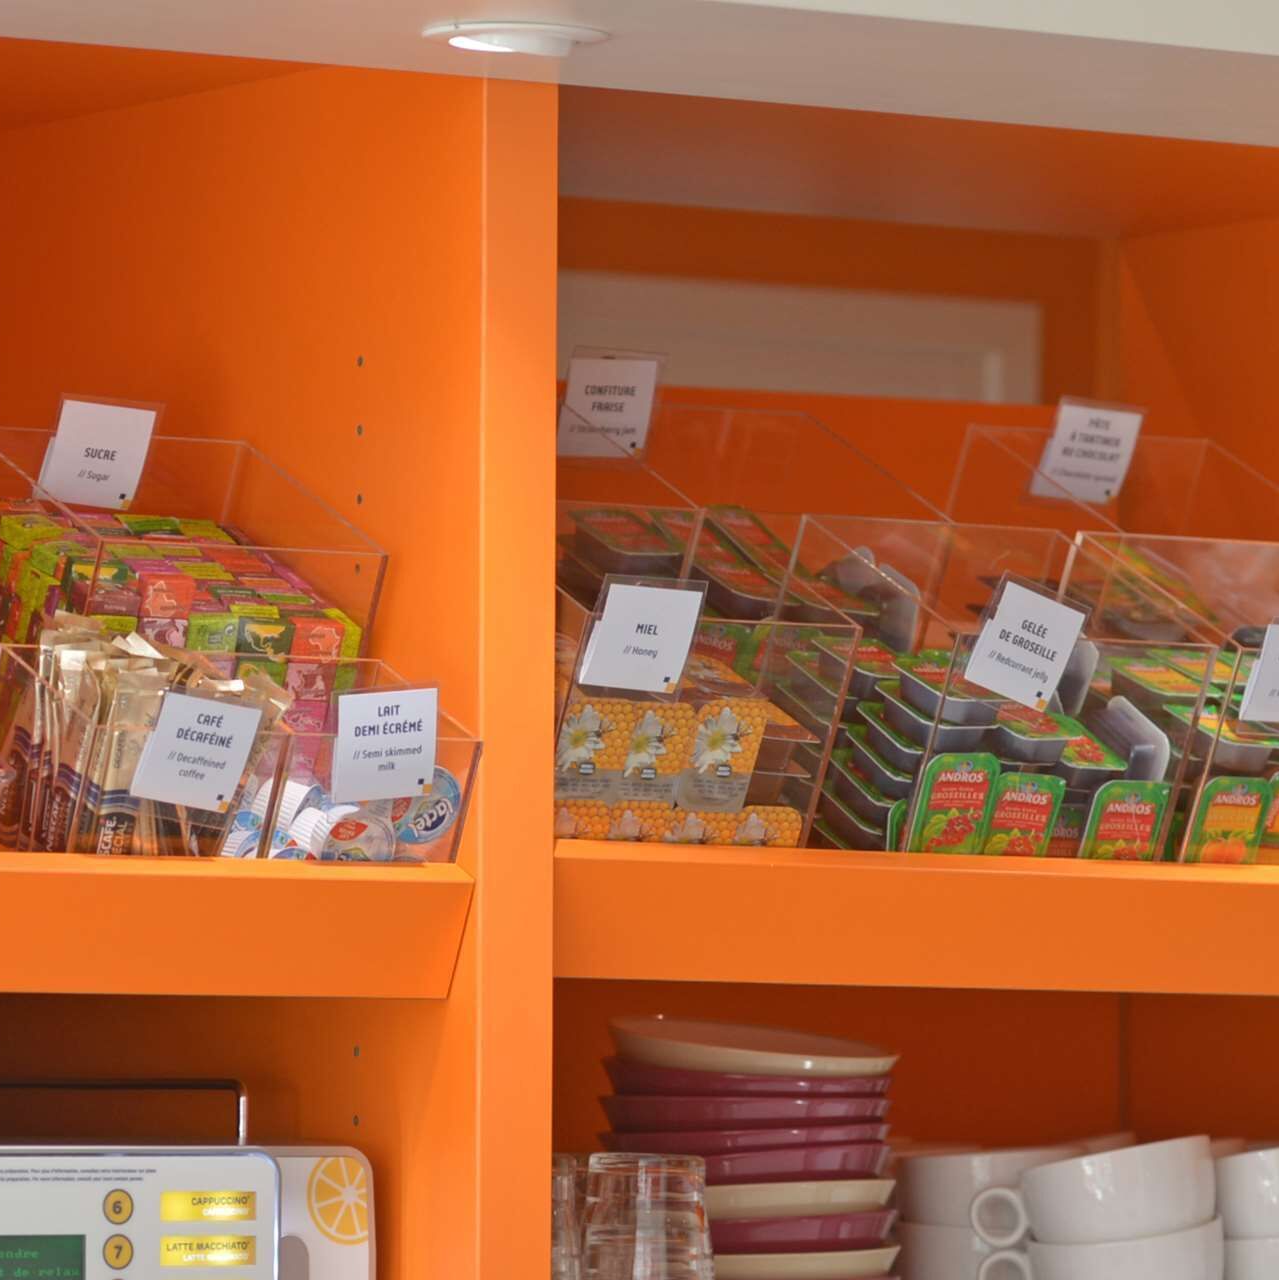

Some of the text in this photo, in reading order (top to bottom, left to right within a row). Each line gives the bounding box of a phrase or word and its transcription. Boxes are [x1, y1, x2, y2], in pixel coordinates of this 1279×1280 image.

[84, 447, 118, 461] SUCRE
[87, 470, 110, 482] Sugar
[635, 623, 658, 636] MIEL
[1021, 619, 1048, 639] GELÉE
[999, 629, 1057, 662] DE GROSEILLE
[632, 646, 658, 659] Honey
[378, 704, 400, 717] LAIT
[196, 713, 224, 728] CAFÉ
[354, 718, 423, 737] DEMI ÉCRÉMÉ
[176, 727, 233, 748] DÉCAFÉINÉ
[362, 745, 422, 759] Semi skimmed
[176, 752, 226, 770] Decaffeined
[378, 761, 395, 771] milk
[178, 768, 205, 781] coffee
[939, 771, 985, 783] ANDROS
[1002, 791, 1048, 805] ANDROS
[1214, 794, 1257, 806] ANDROS
[1106, 803, 1153, 815] ANDROS
[112, 1200, 123, 1215] 6
[191, 1196, 248, 1206] CAPPUCCINO
[113, 1245, 124, 1260] 7
[166, 1241, 248, 1251] LATTE MACCHIATO
